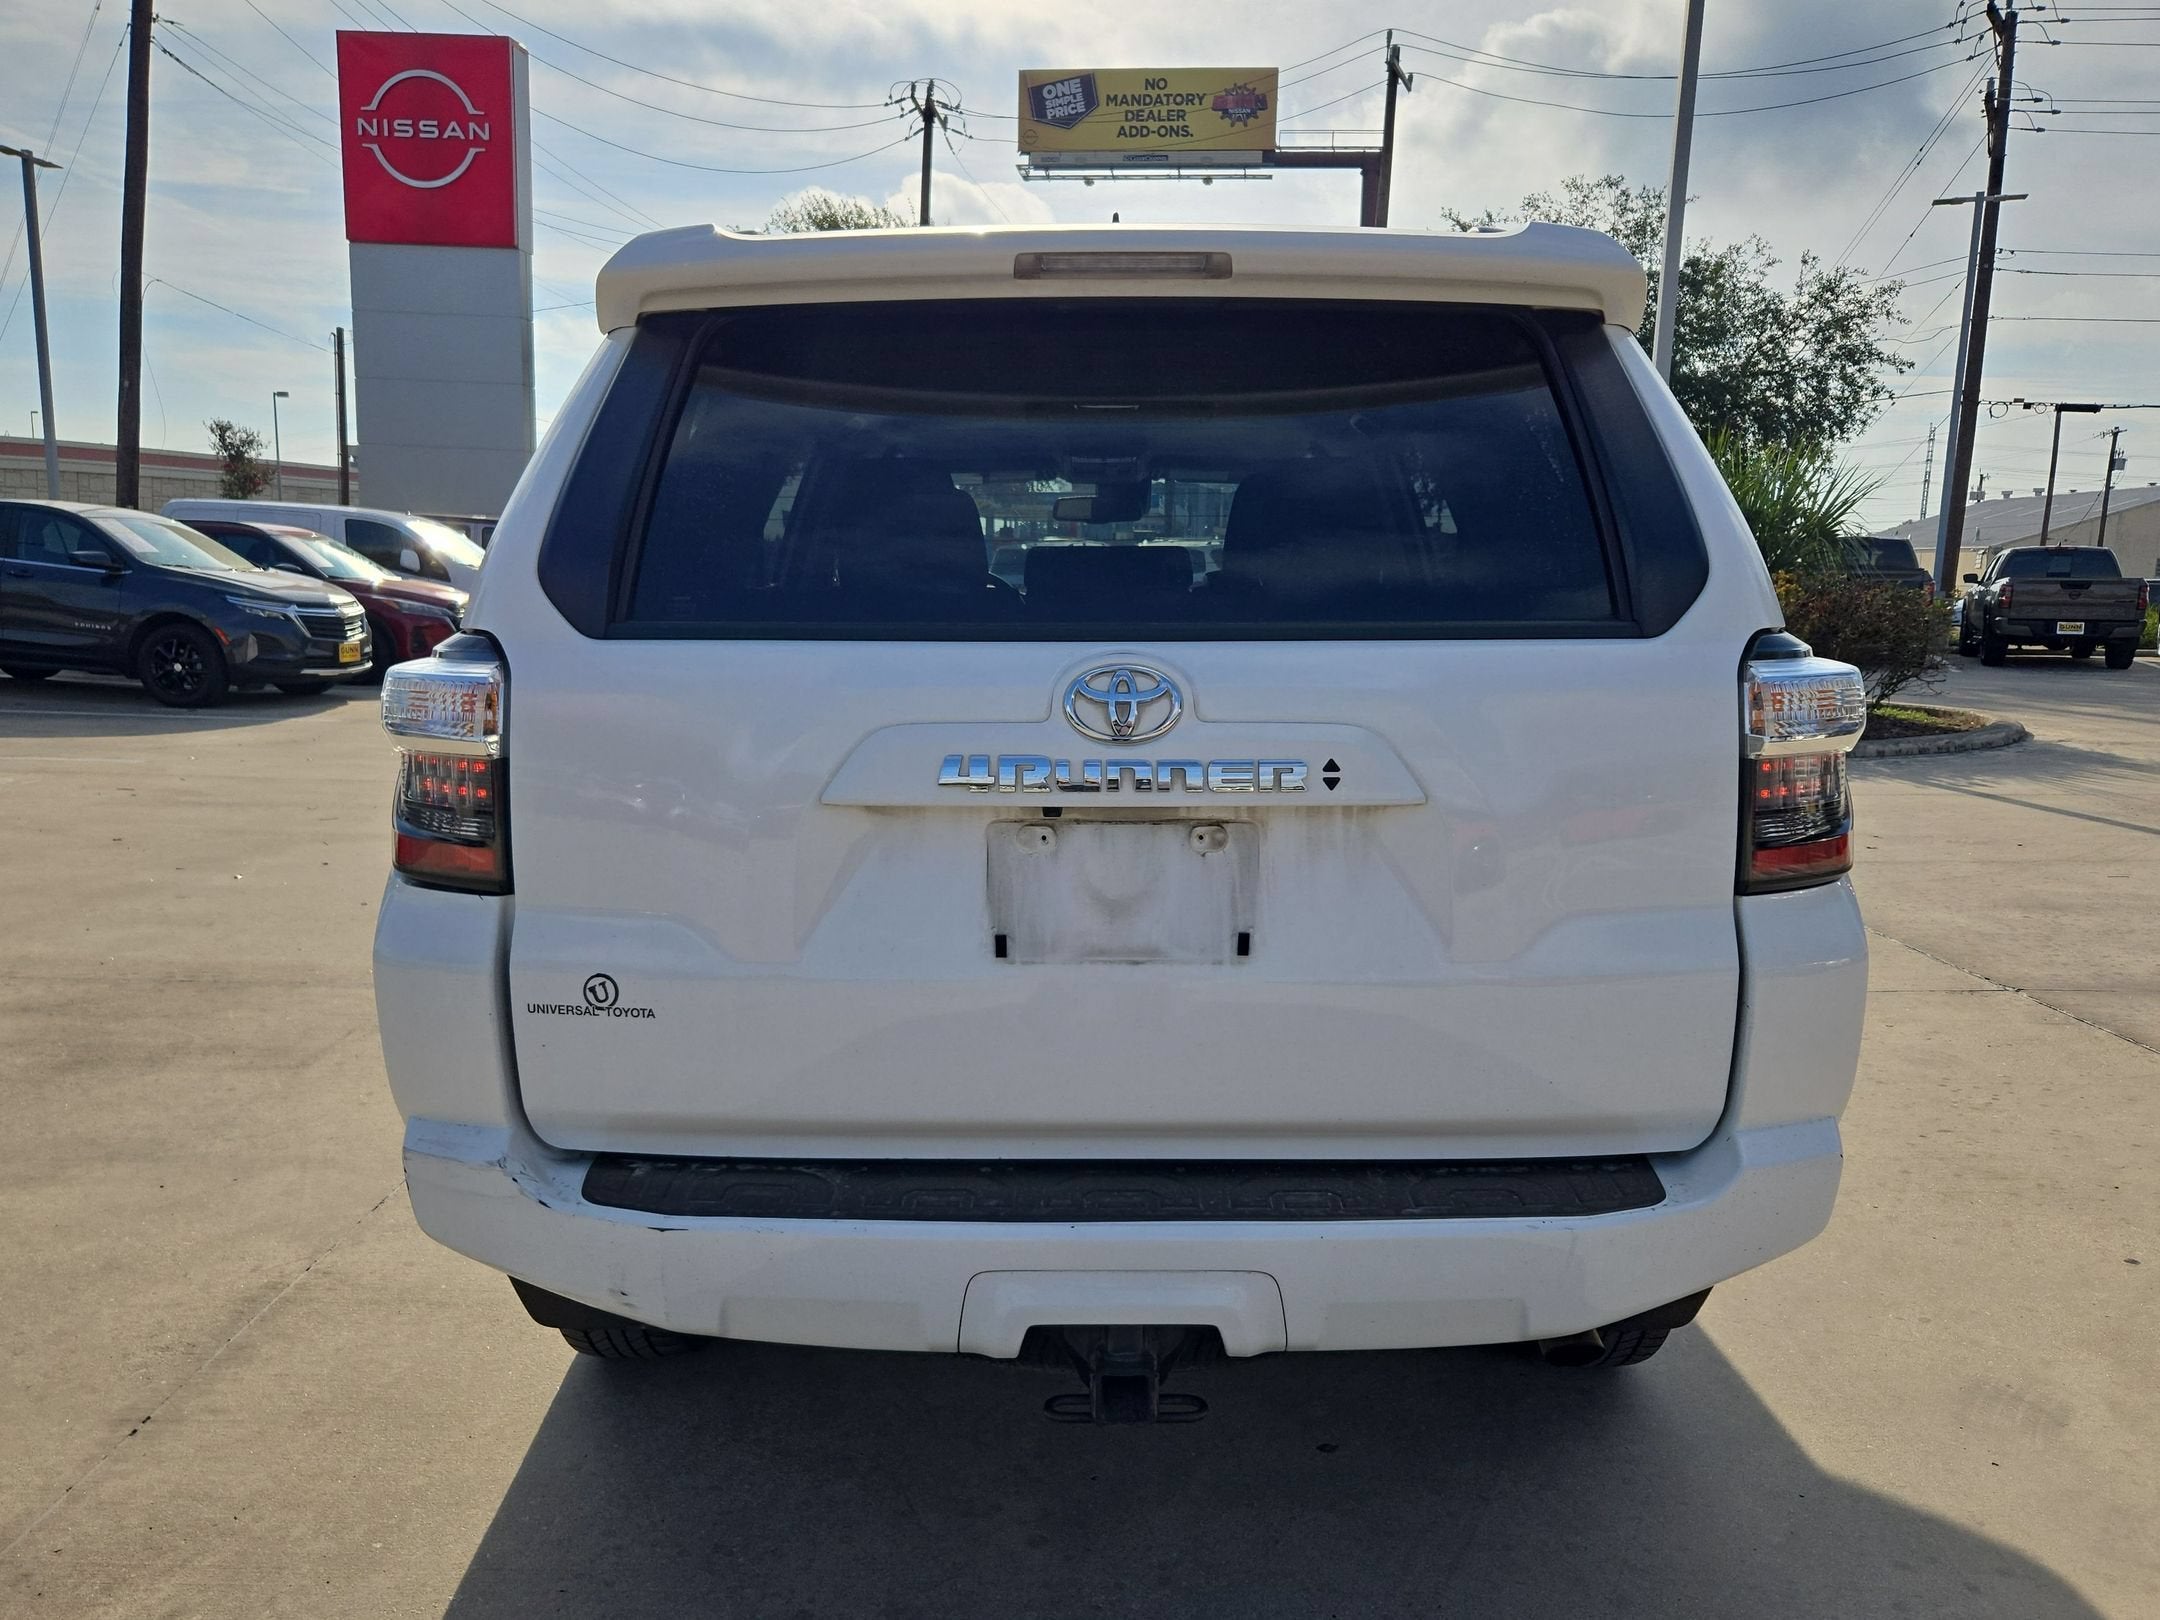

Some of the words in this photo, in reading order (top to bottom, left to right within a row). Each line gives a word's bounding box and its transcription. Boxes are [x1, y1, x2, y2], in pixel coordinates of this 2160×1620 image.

[1043, 79, 1083, 99] ONE
[1144, 78, 1168, 90] NO
[1045, 93, 1085, 109] SIMPLE
[1105, 93, 1207, 106] MANDATORY
[1046, 102, 1086, 119] PRICE
[1125, 109, 1187, 122] DEALER
[357, 118, 490, 141] NISSAN
[1117, 125, 1194, 138] ADD-ONS.
[527, 1003, 600, 1016] UNIVERSAL
[605, 1006, 656, 1019] TOYOTA
